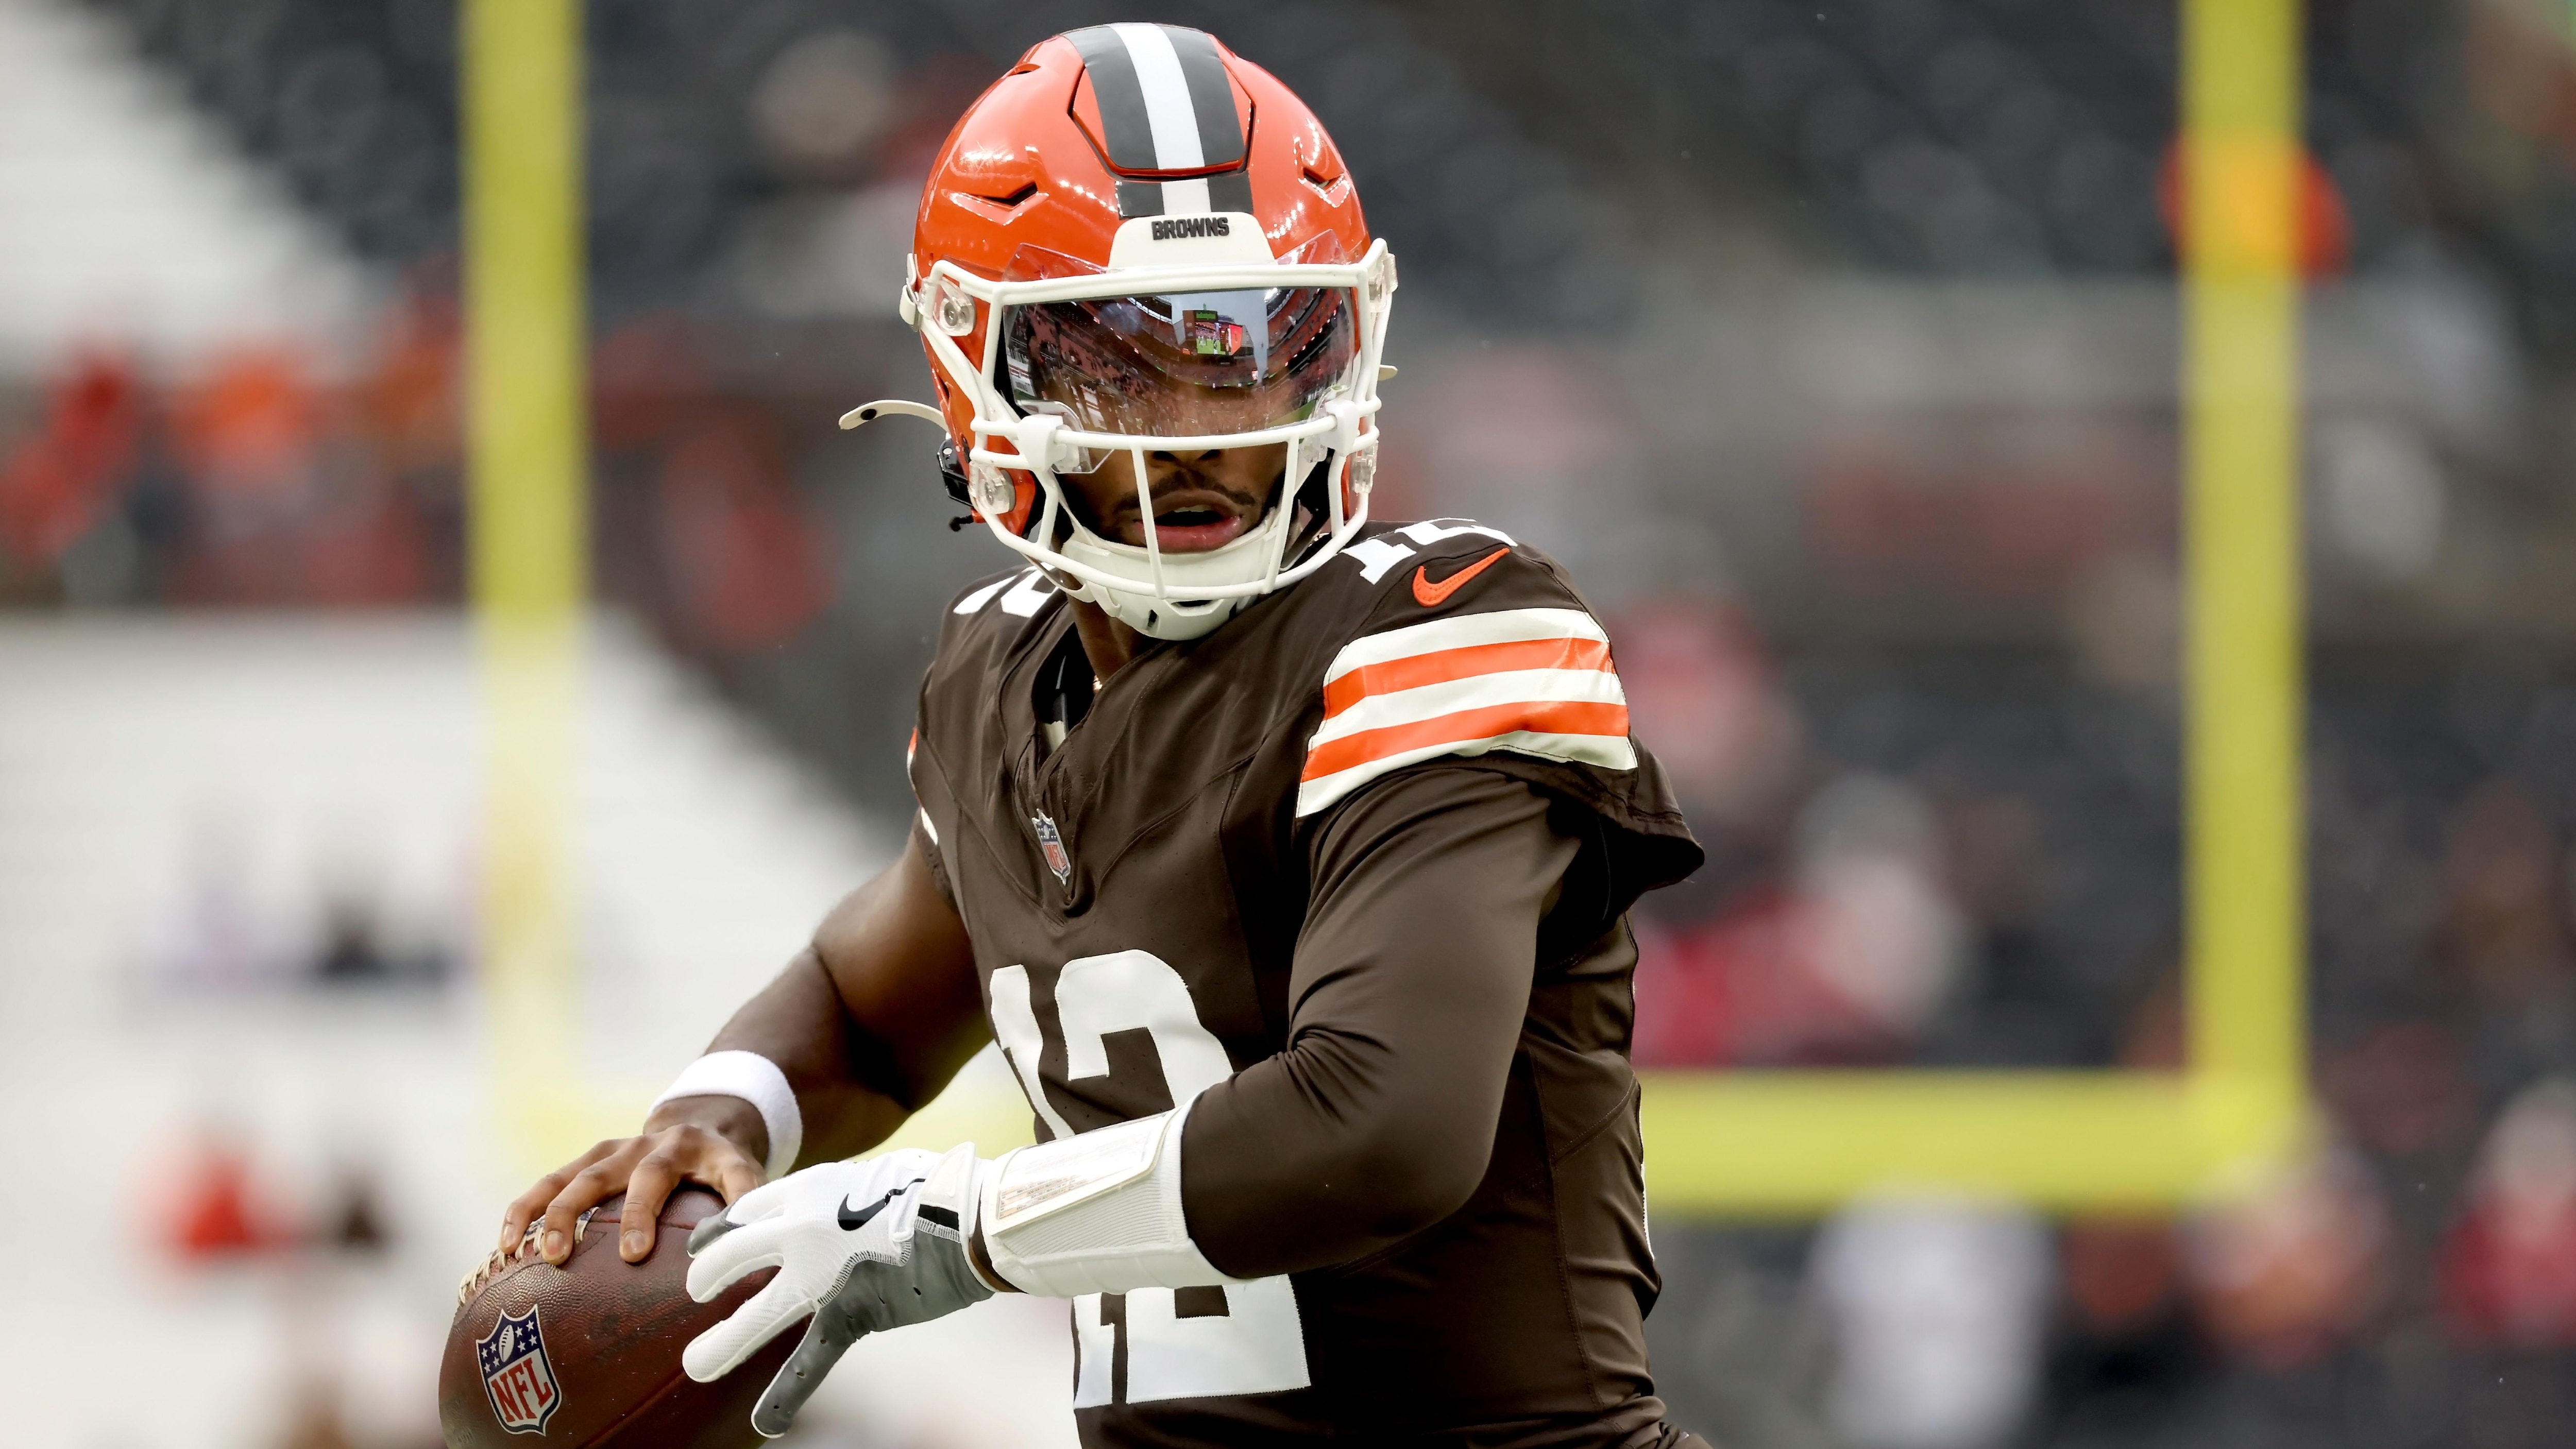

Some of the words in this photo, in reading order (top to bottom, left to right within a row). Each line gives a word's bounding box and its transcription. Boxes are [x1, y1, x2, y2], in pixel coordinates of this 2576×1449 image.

[1151, 217, 1229, 240] BROWNS
[990, 949, 1311, 1409] 12
[491, 1357, 553, 1422] NFL
